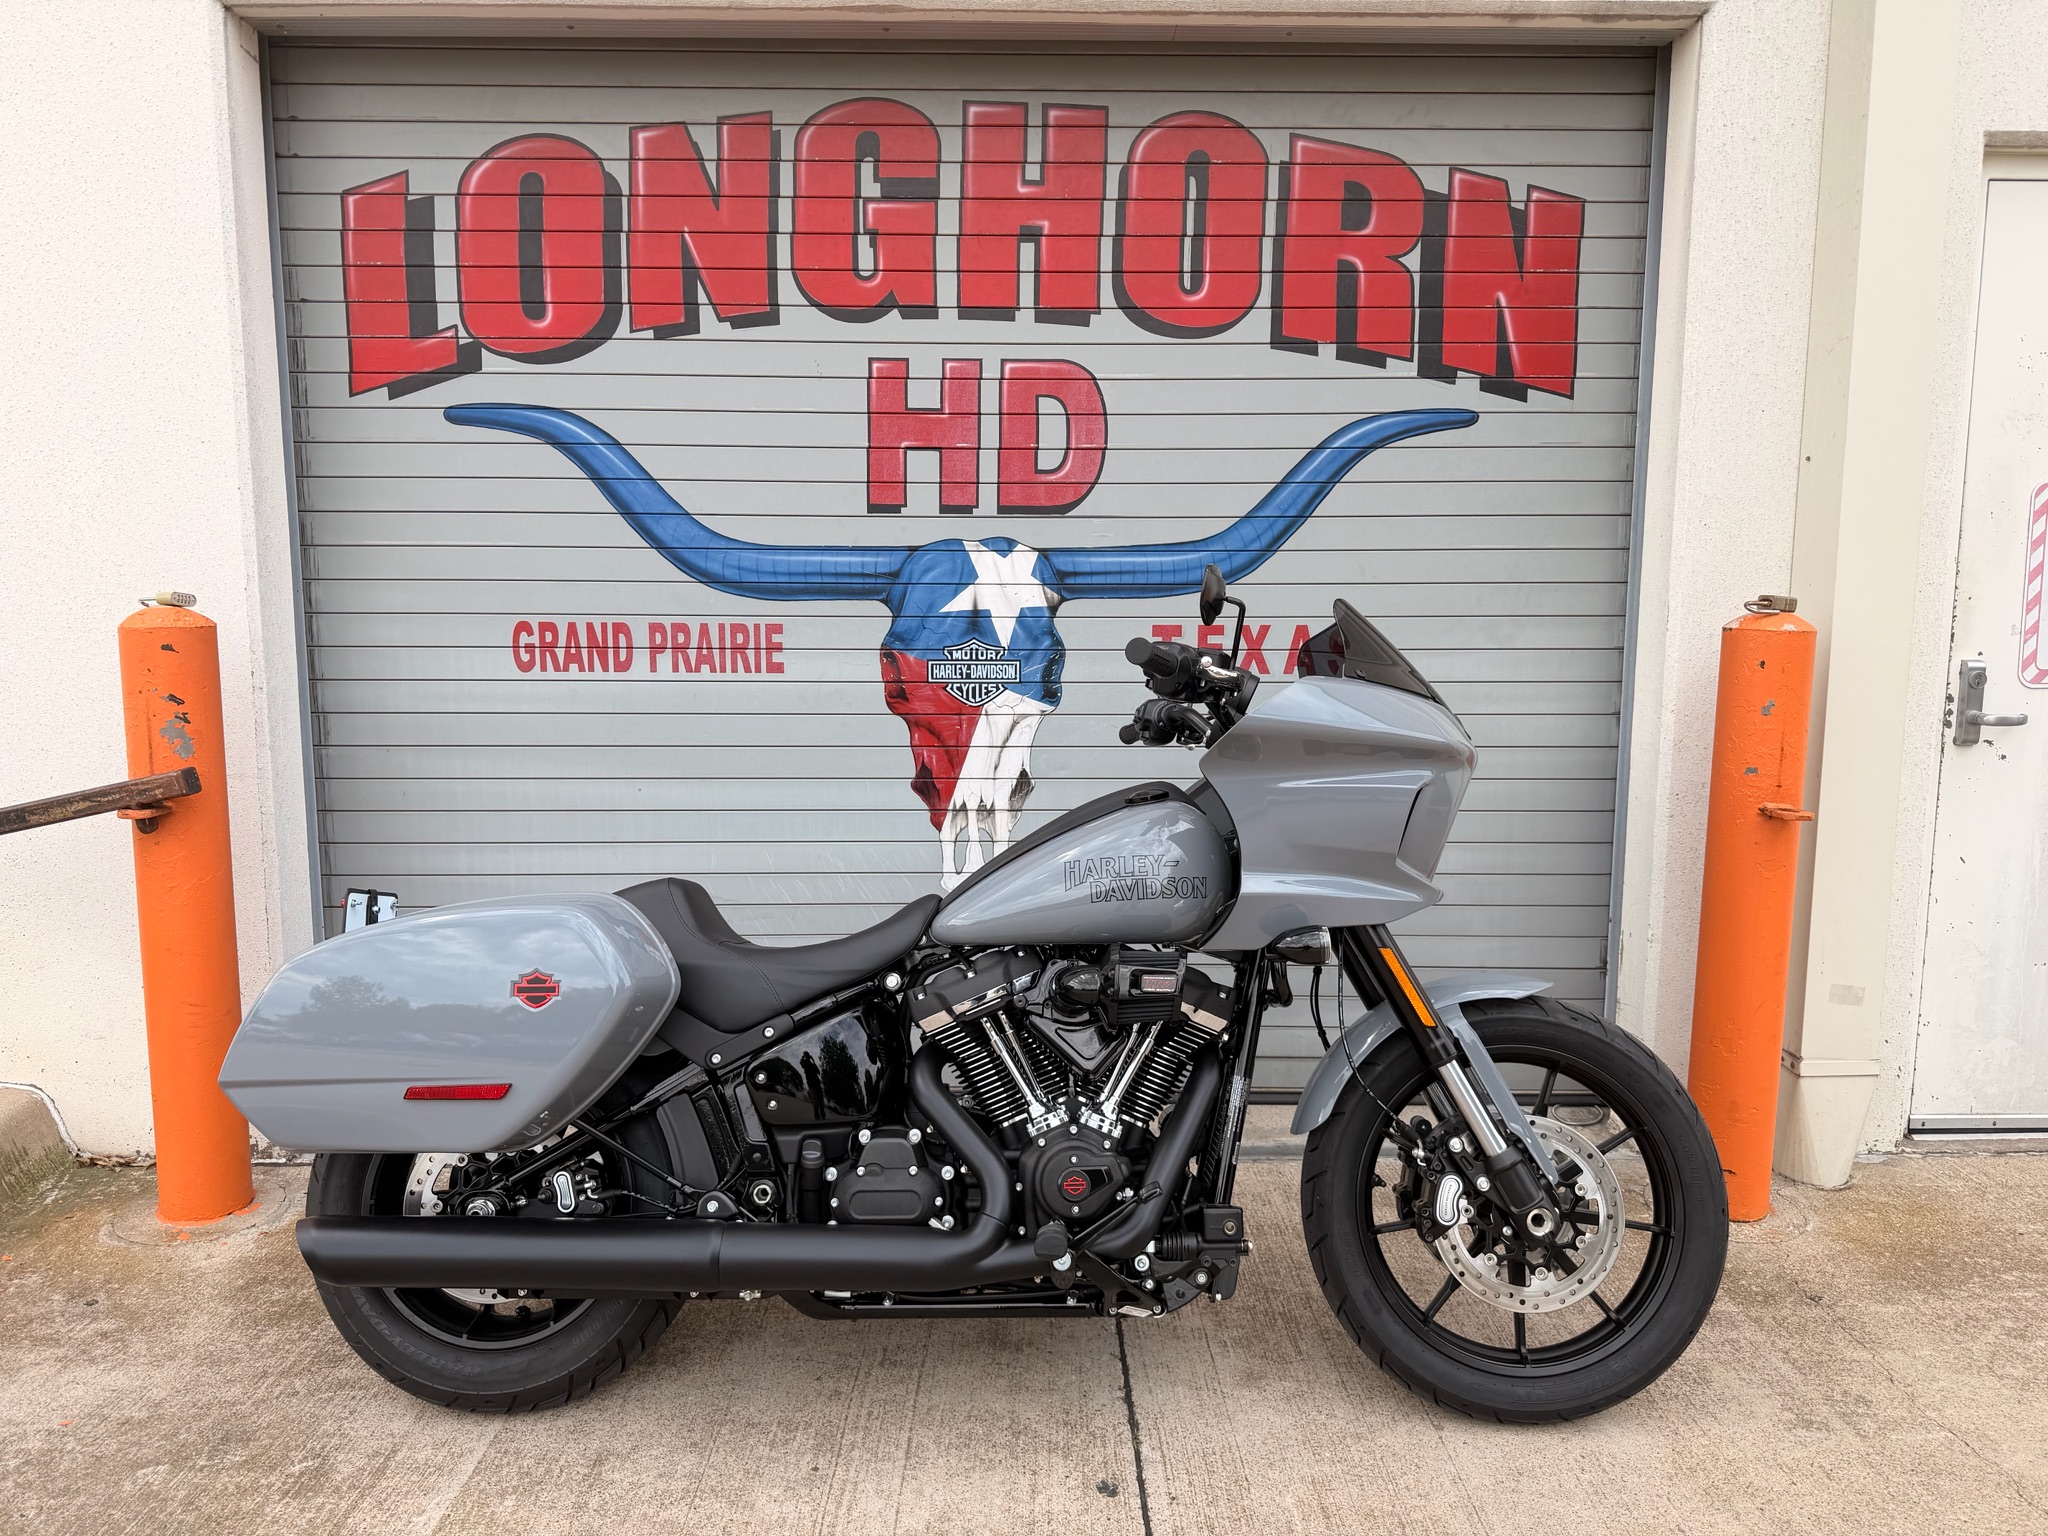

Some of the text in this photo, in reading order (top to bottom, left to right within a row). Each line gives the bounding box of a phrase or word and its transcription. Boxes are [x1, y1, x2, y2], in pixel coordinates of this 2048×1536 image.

[342, 97, 1586, 403] LONGHORN
[867, 358, 1108, 515] HD
[512, 620, 785, 674] GRAND PRAIRIE
[952, 643, 996, 660] MOTOR
[932, 664, 1016, 679] HARLEY-DAVIDSON
[953, 683, 998, 703] CYCLES
[1064, 854, 1180, 892] HARLEY-
[1089, 877, 1207, 904] DAVIDSON
[350, 1287, 482, 1377] HARLEY-DAV
